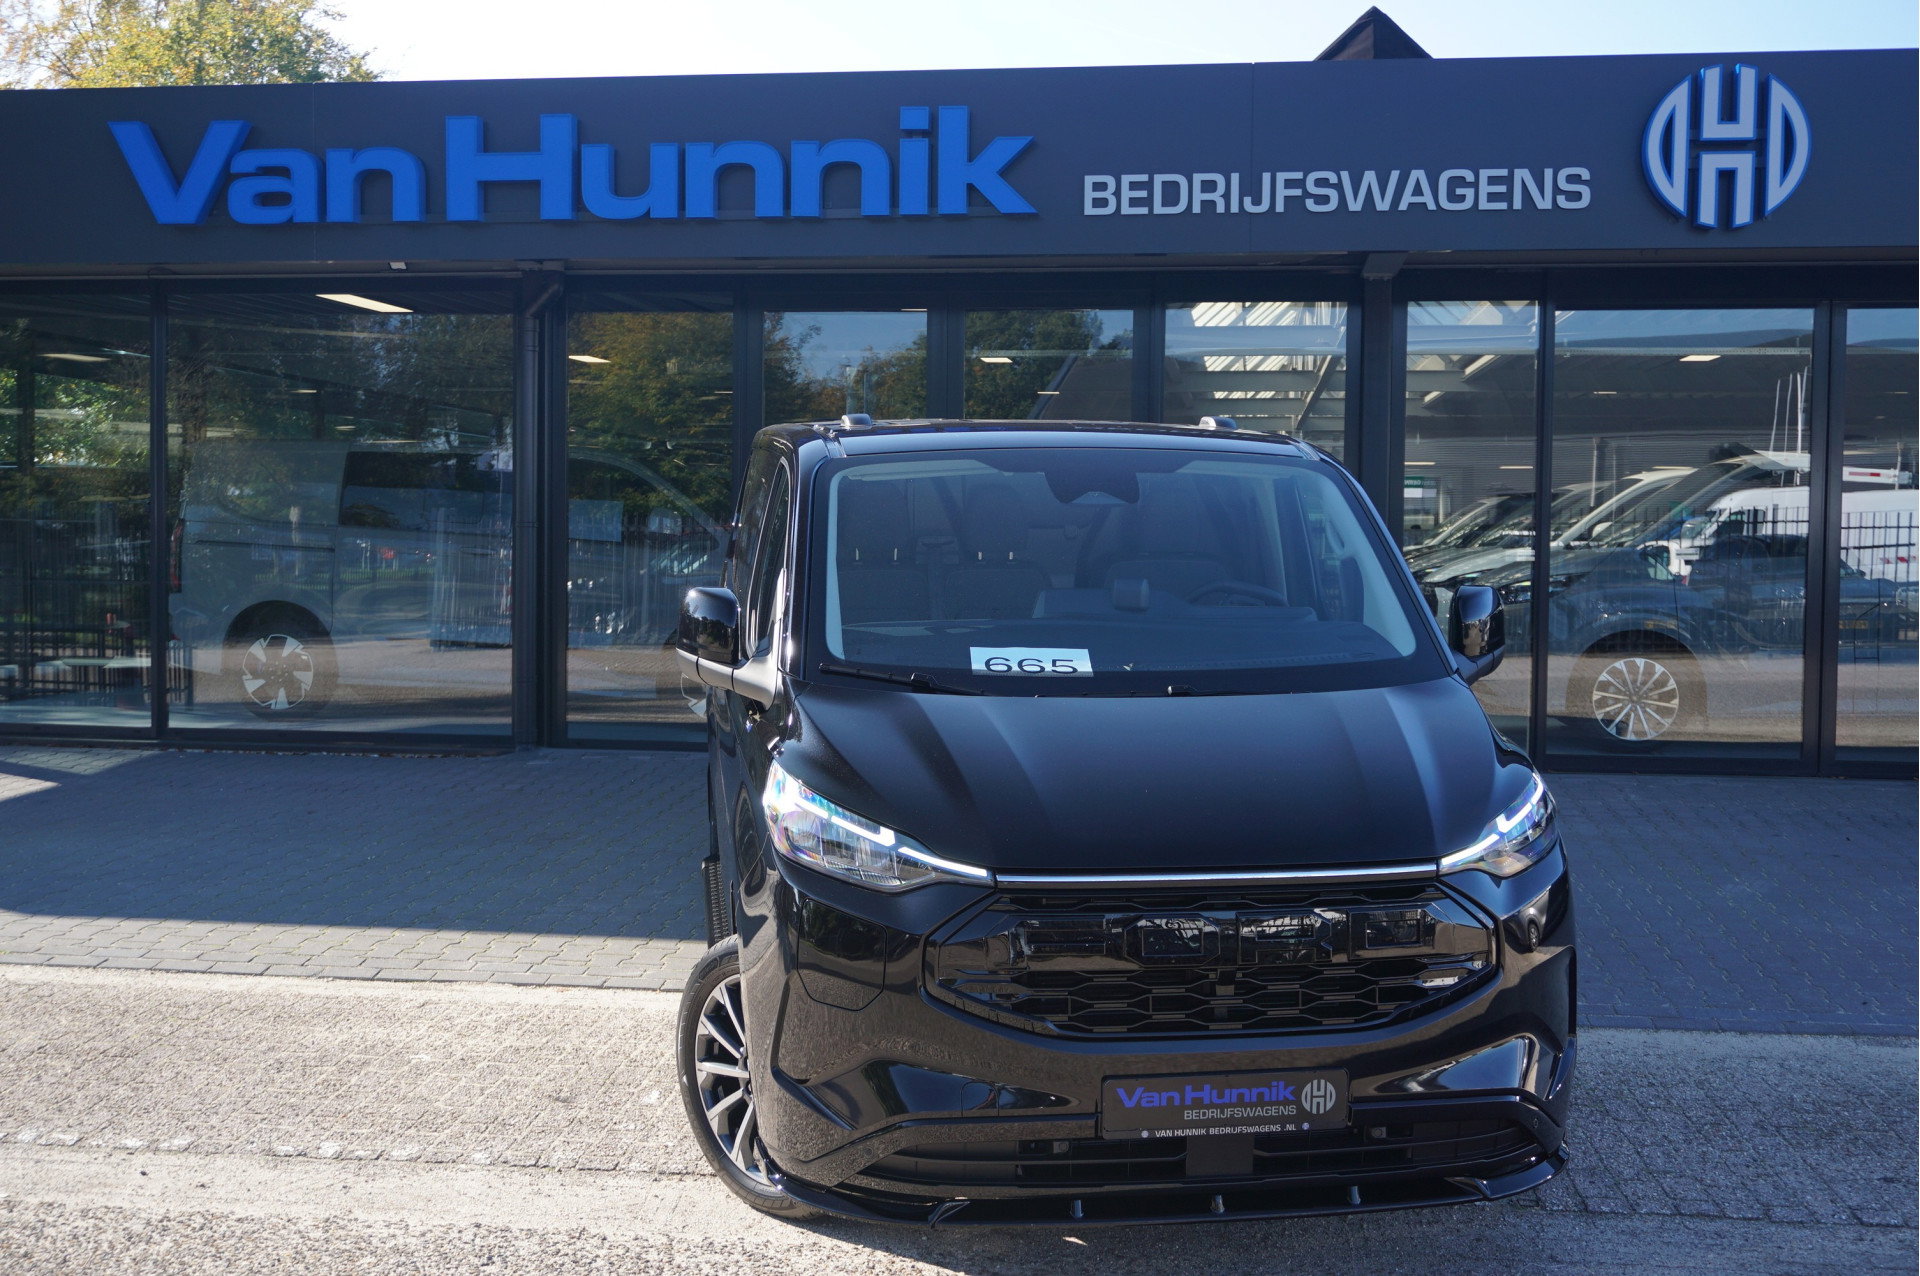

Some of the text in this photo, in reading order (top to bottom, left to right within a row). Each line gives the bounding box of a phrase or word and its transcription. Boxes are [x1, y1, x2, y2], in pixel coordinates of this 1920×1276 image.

[108, 104, 1039, 226] Van Hunnik
[1082, 166, 1592, 217] BEDRIJFSWAGENS
[984, 656, 1079, 675] 665
[1116, 1081, 1297, 1108] Van Hunnik
[1183, 1105, 1297, 1120] BEDRIJFSWAGENS
[1155, 1129, 1174, 1138] VAN
[1174, 1127, 1207, 1137] HUNNIK
[1209, 1124, 1282, 1135] BEDRIJFSWAGENS
